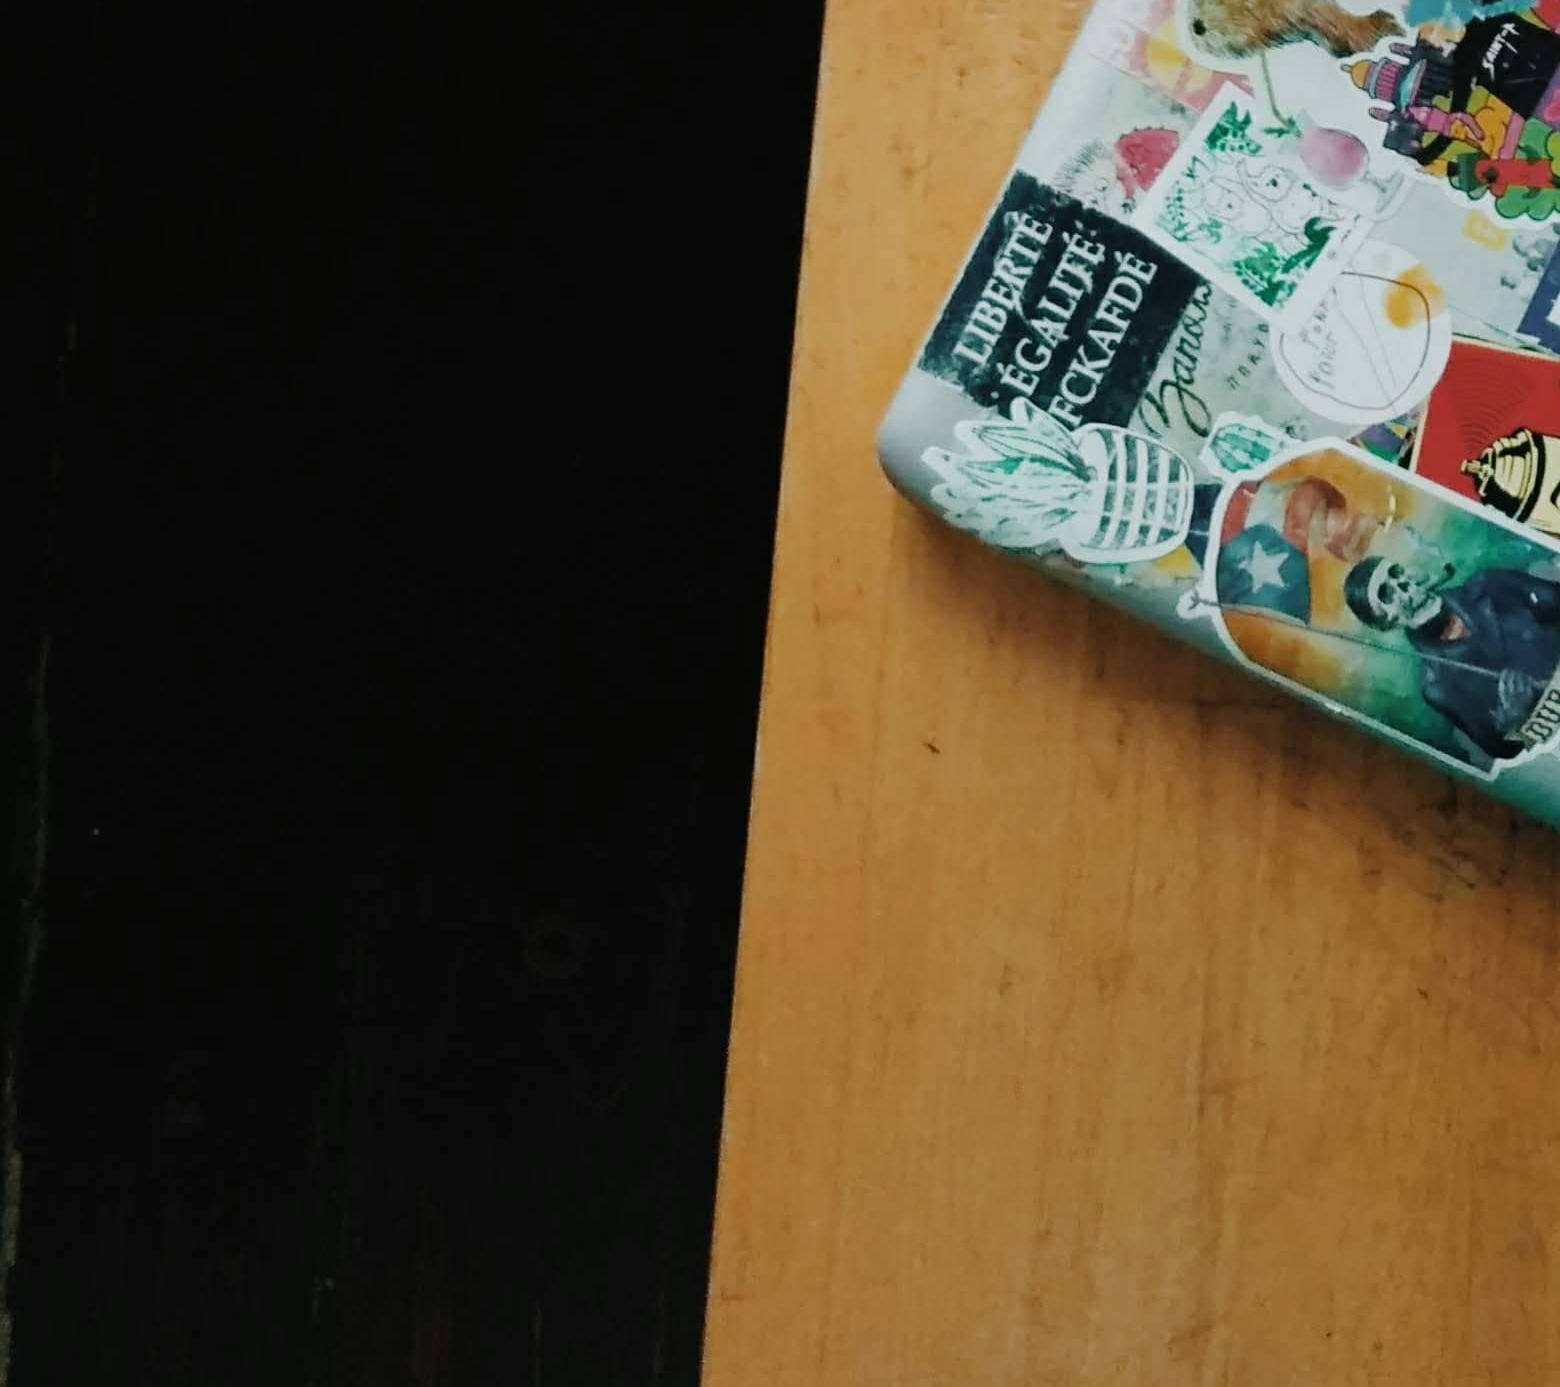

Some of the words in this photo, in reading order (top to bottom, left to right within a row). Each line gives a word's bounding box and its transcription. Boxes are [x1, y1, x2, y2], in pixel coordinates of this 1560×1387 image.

[955, 213, 1051, 366] LIBERTÉ
[998, 234, 1104, 394] ÉGALITÉ
[1048, 253, 1155, 427] FCKAFDÉ
